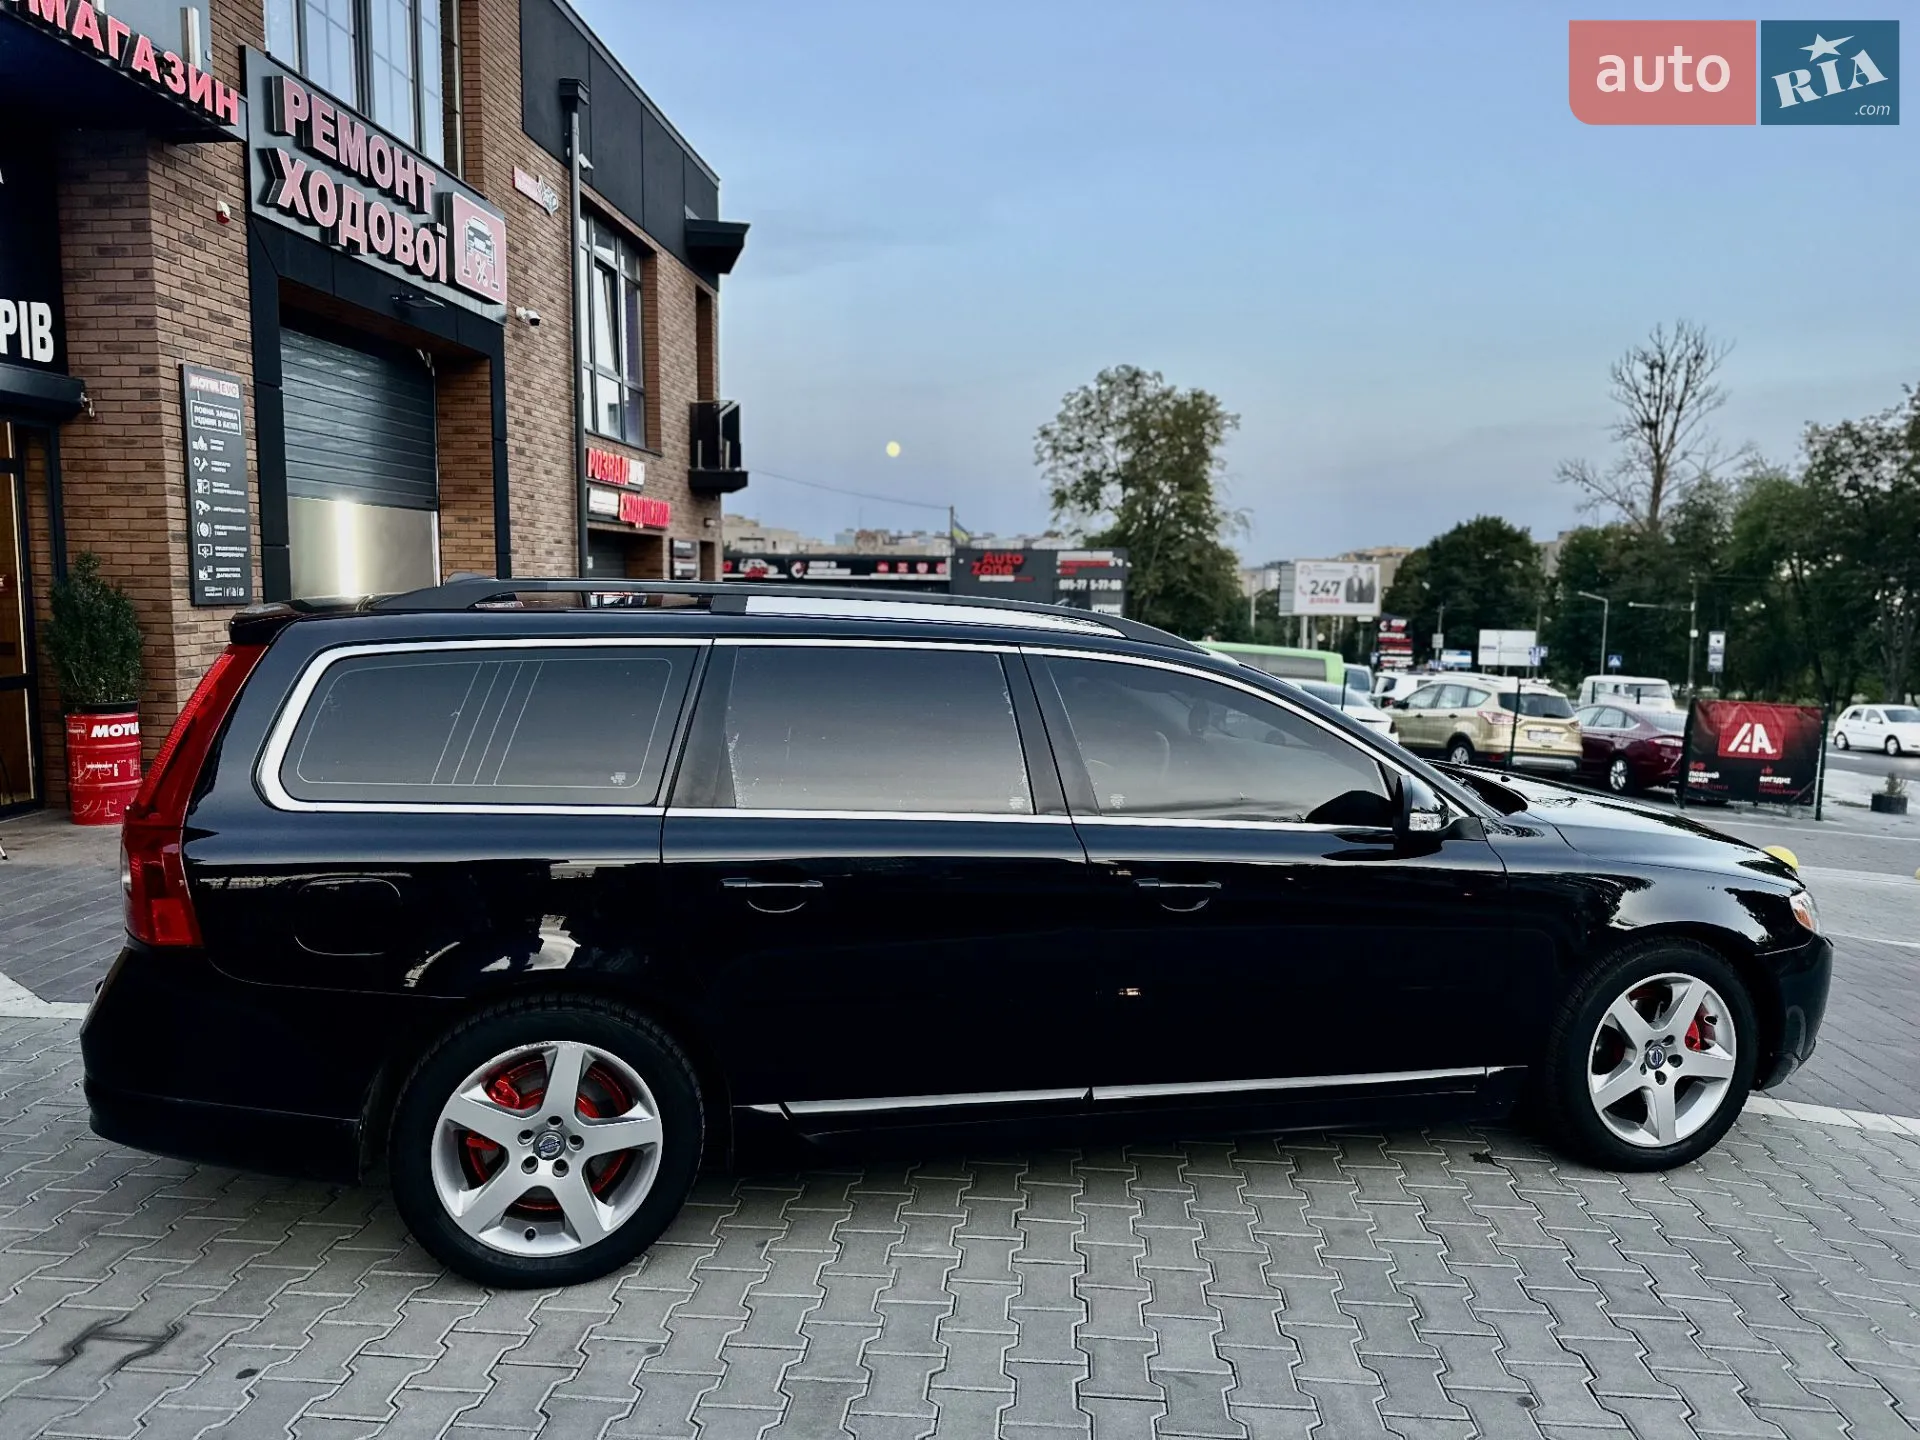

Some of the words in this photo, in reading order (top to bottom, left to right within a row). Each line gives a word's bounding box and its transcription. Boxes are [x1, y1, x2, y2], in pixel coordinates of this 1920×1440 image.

[281, 75, 436, 215] РЕМОНТ
[276, 147, 447, 284] ХОДОВОЇ
[587, 447, 628, 485] РОЗВАЛ
[971, 562, 1013, 575] Zone
[983, 552, 1023, 564] Auto
[1309, 580, 1341, 596] 247
